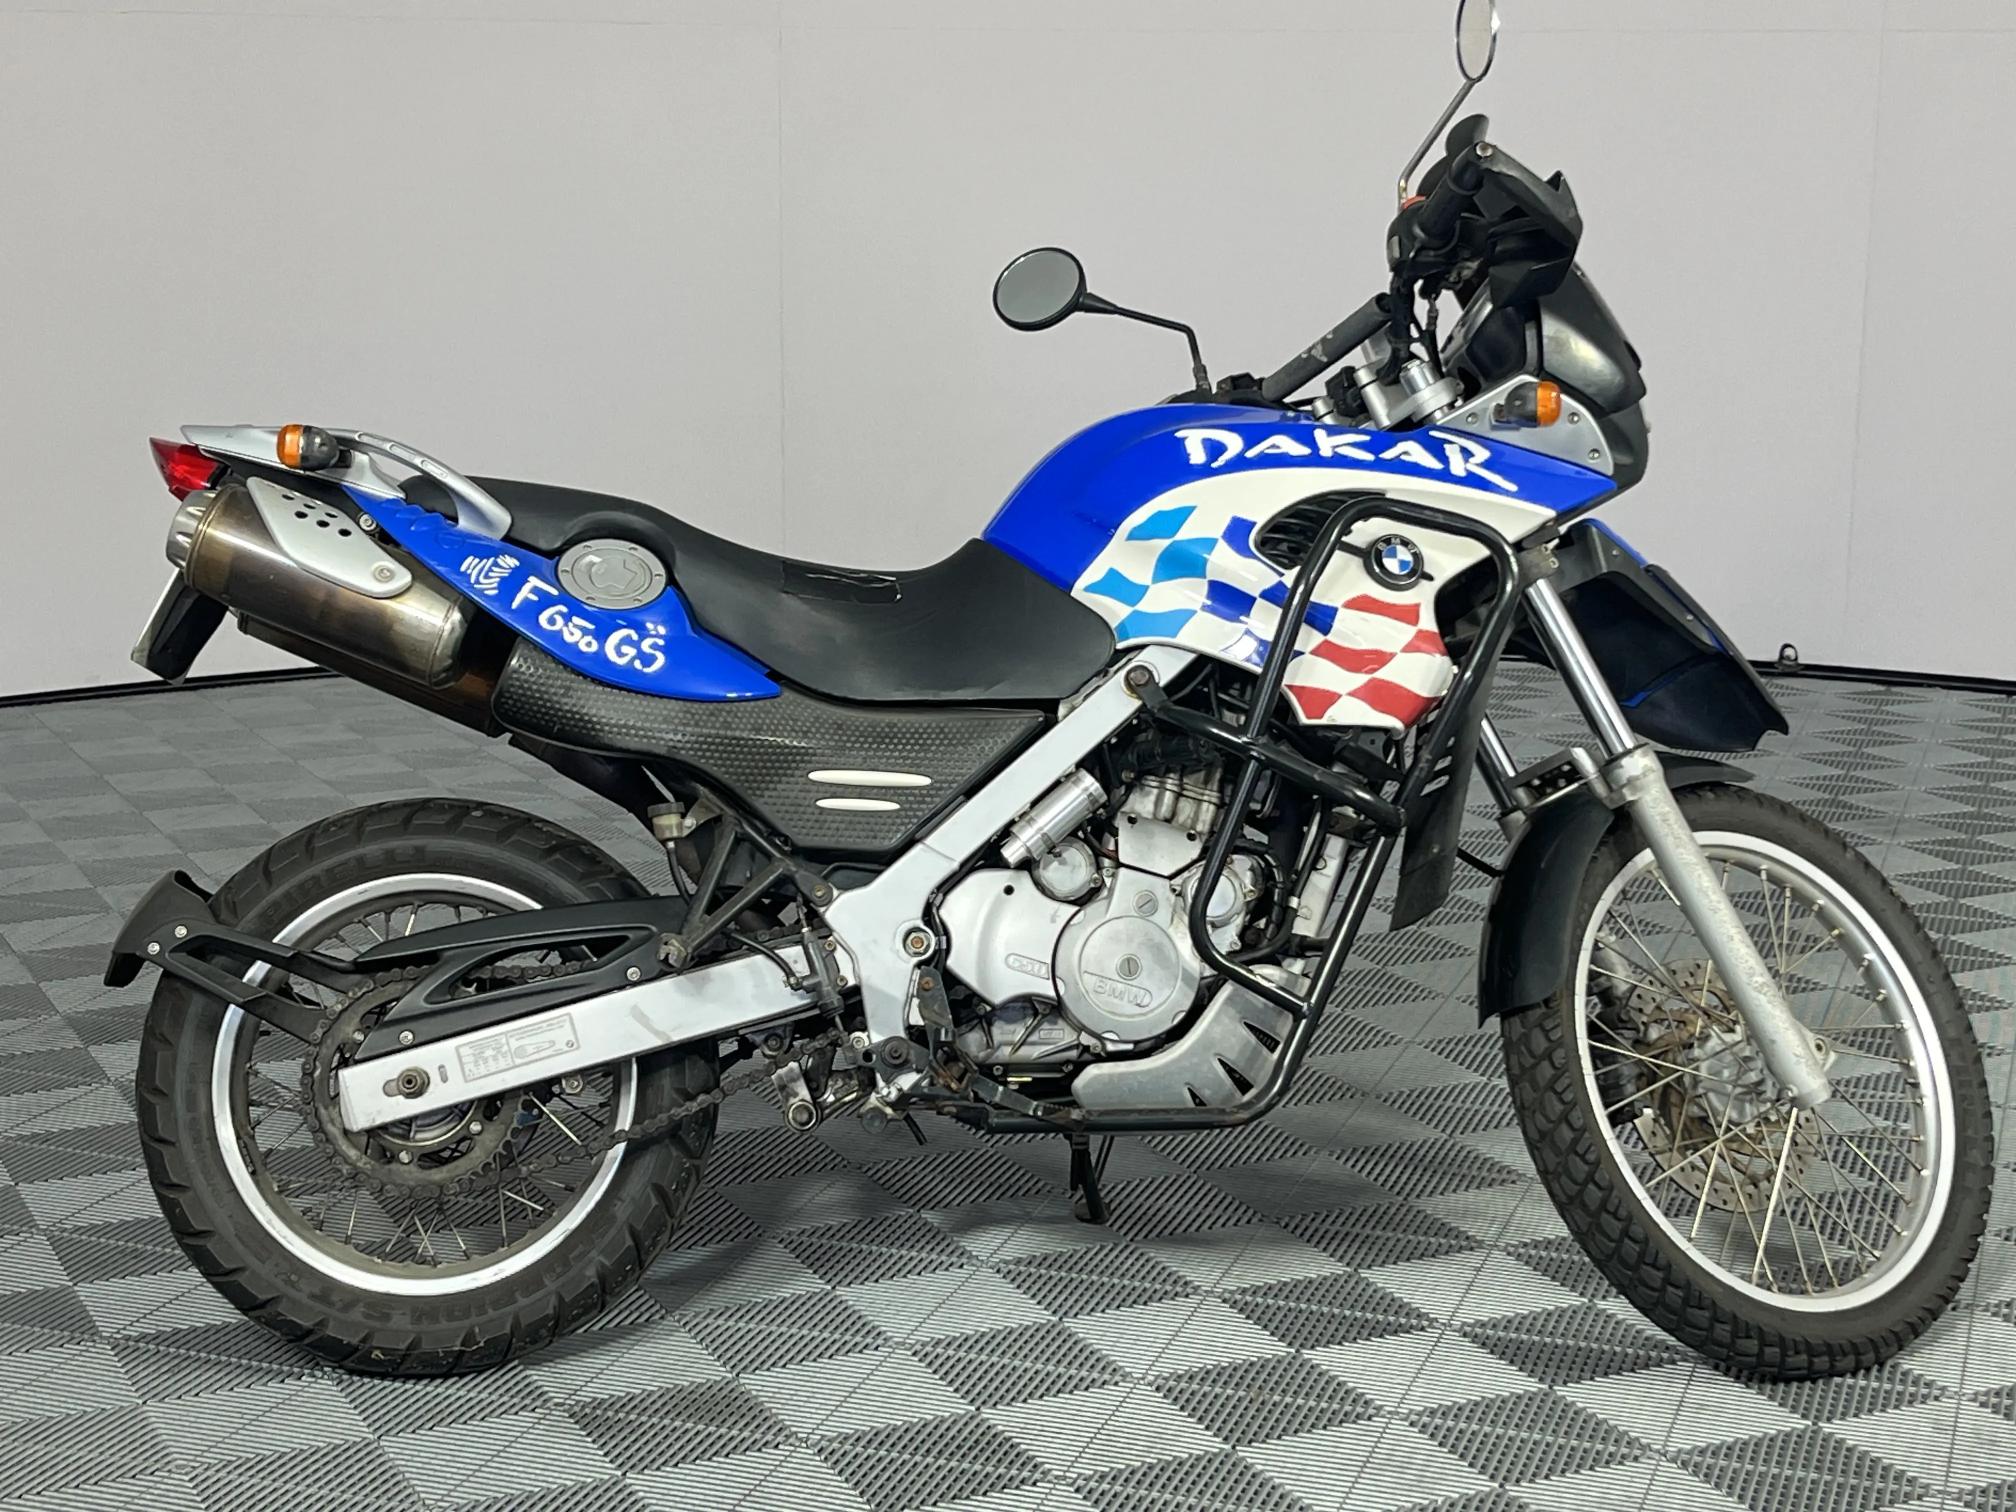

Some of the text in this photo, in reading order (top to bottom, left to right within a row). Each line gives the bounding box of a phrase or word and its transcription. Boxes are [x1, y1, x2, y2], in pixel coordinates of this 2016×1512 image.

[1174, 428, 1519, 492] DAKAR
[511, 575, 666, 673] F 650 GS
[1093, 979, 1147, 1005] BMW
